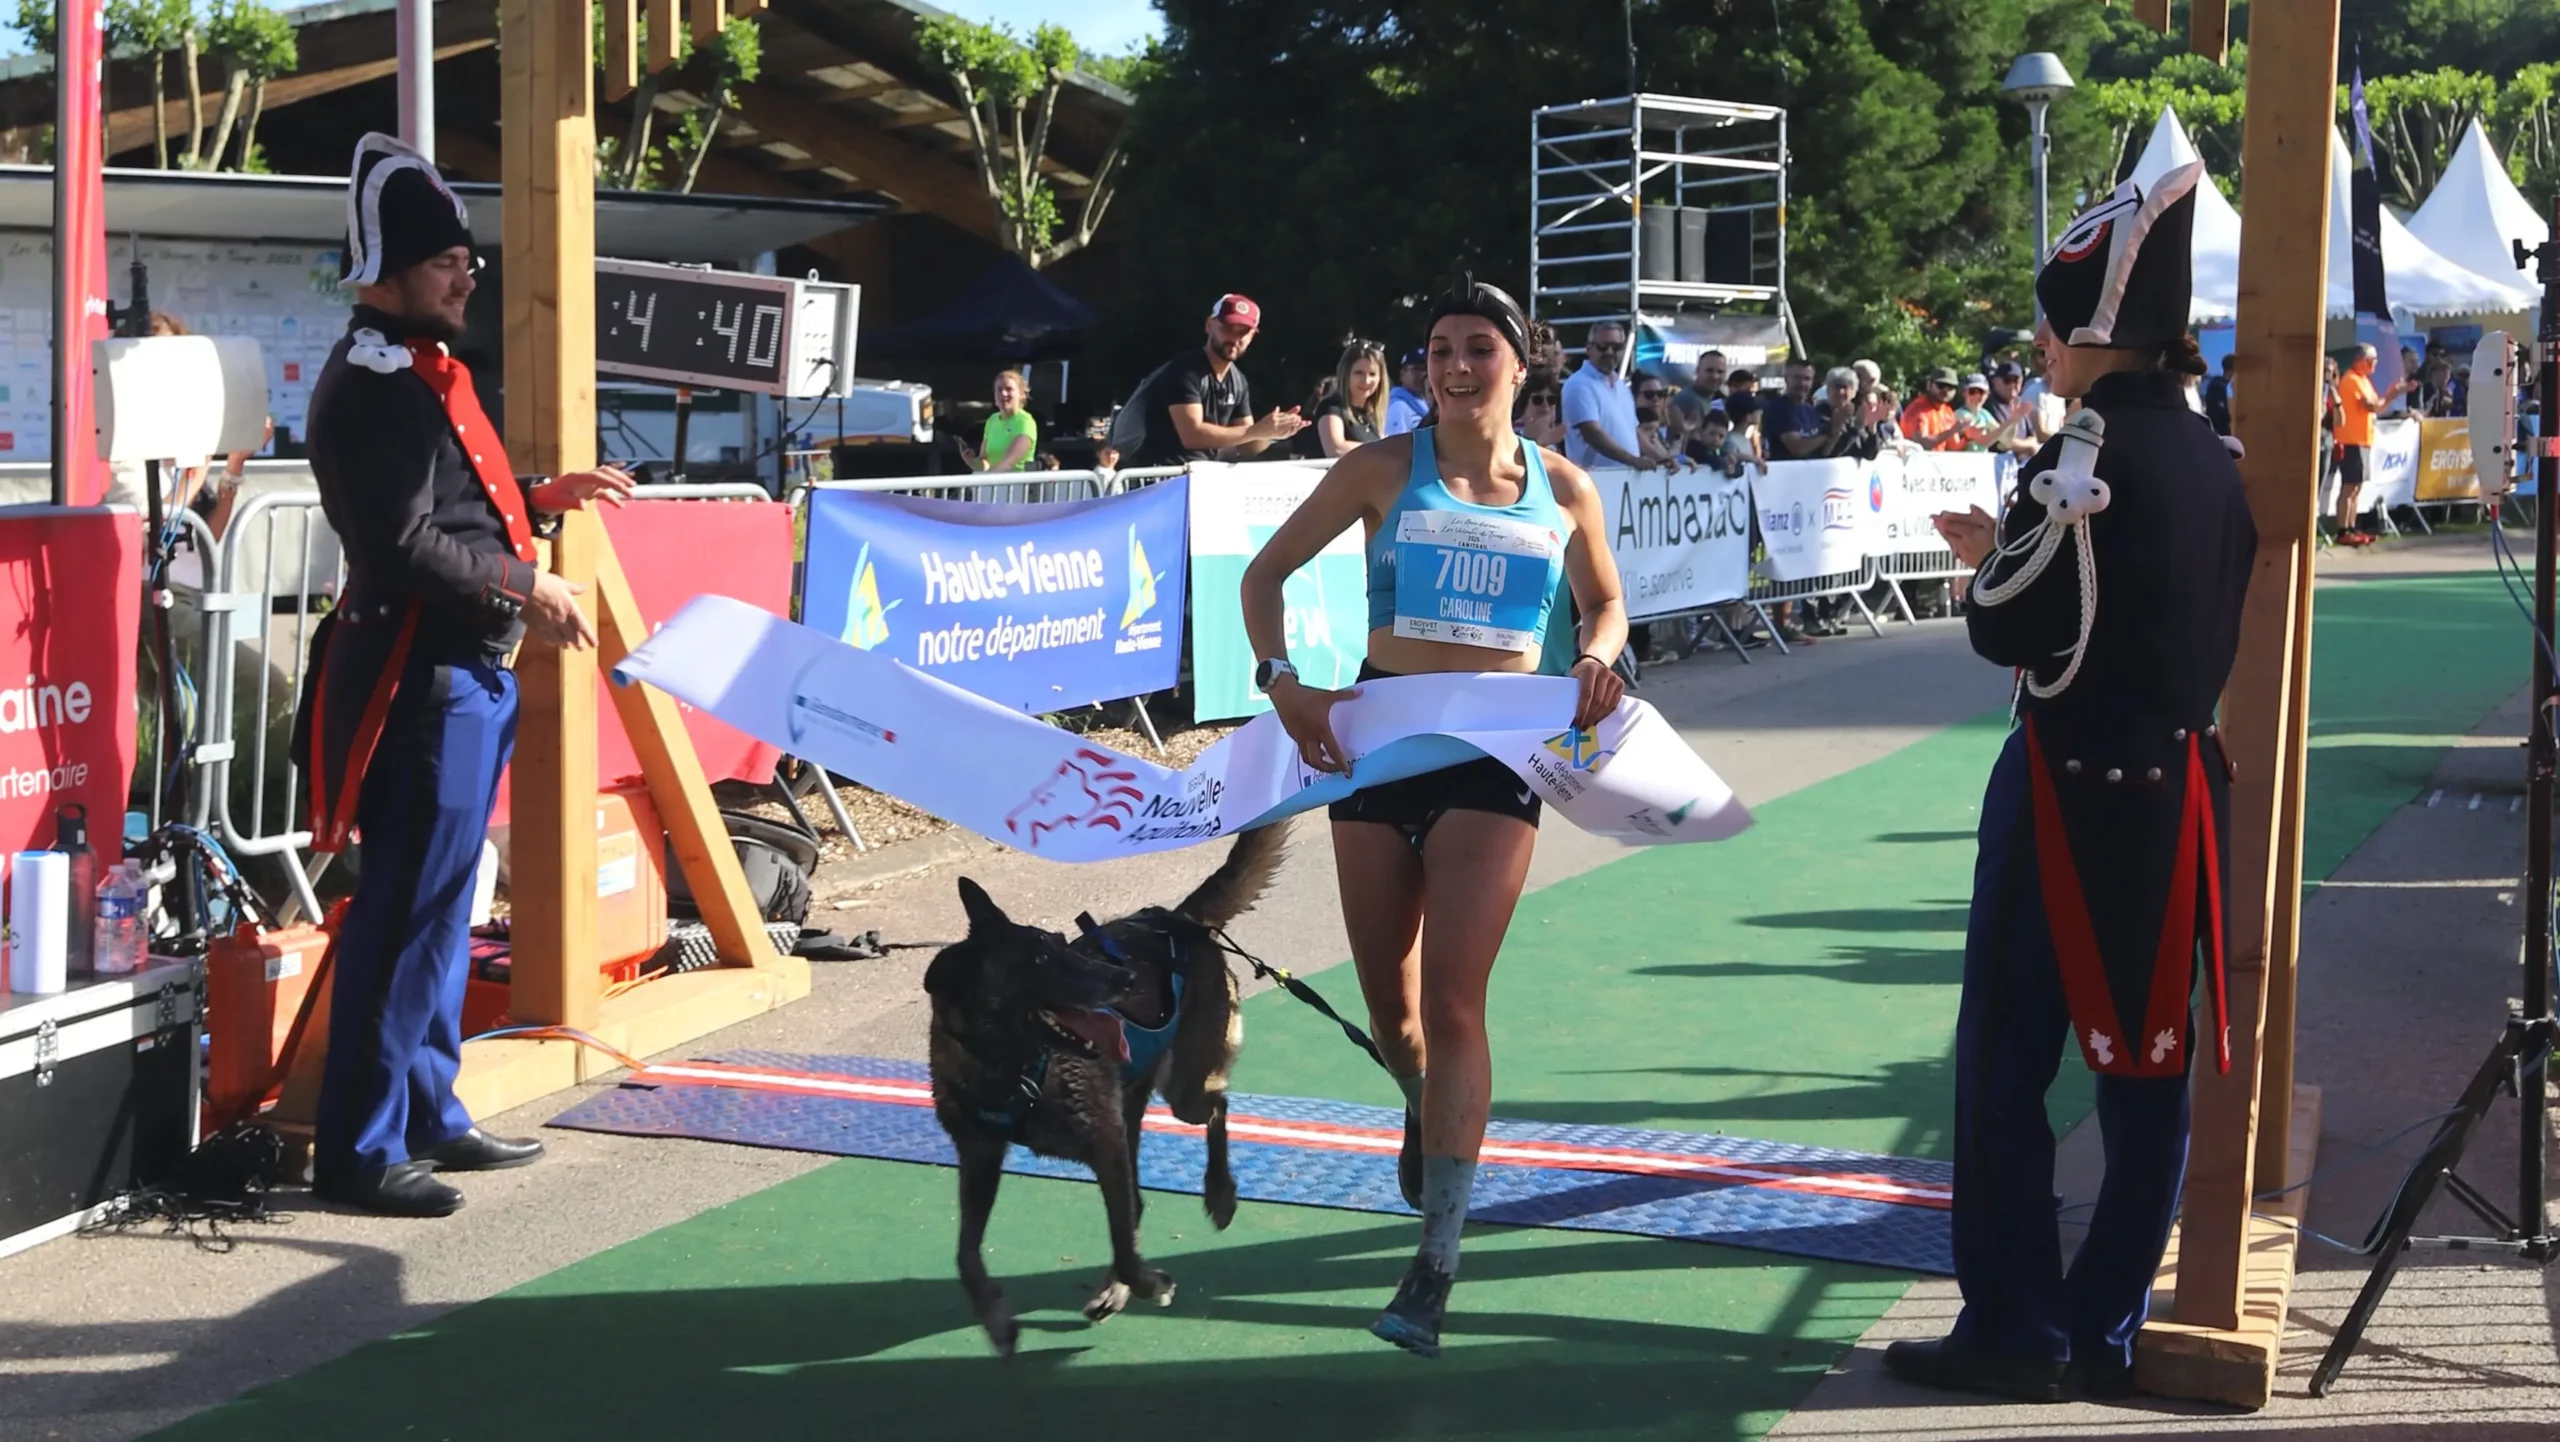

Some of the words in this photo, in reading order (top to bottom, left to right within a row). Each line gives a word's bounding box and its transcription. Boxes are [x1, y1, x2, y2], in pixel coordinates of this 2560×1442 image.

[1617, 480, 1746, 552] Ambazac
[920, 541, 1104, 605] Haute-Vienne
[1435, 548, 1507, 597] 7009
[1439, 596, 1493, 623] CAROLINE
[918, 622, 984, 667] notre
[986, 607, 1107, 662] département
[1527, 752, 1575, 802] Haute-Vienne
[1553, 760, 1586, 795] département
[1118, 815, 1222, 846] Aquitaine
